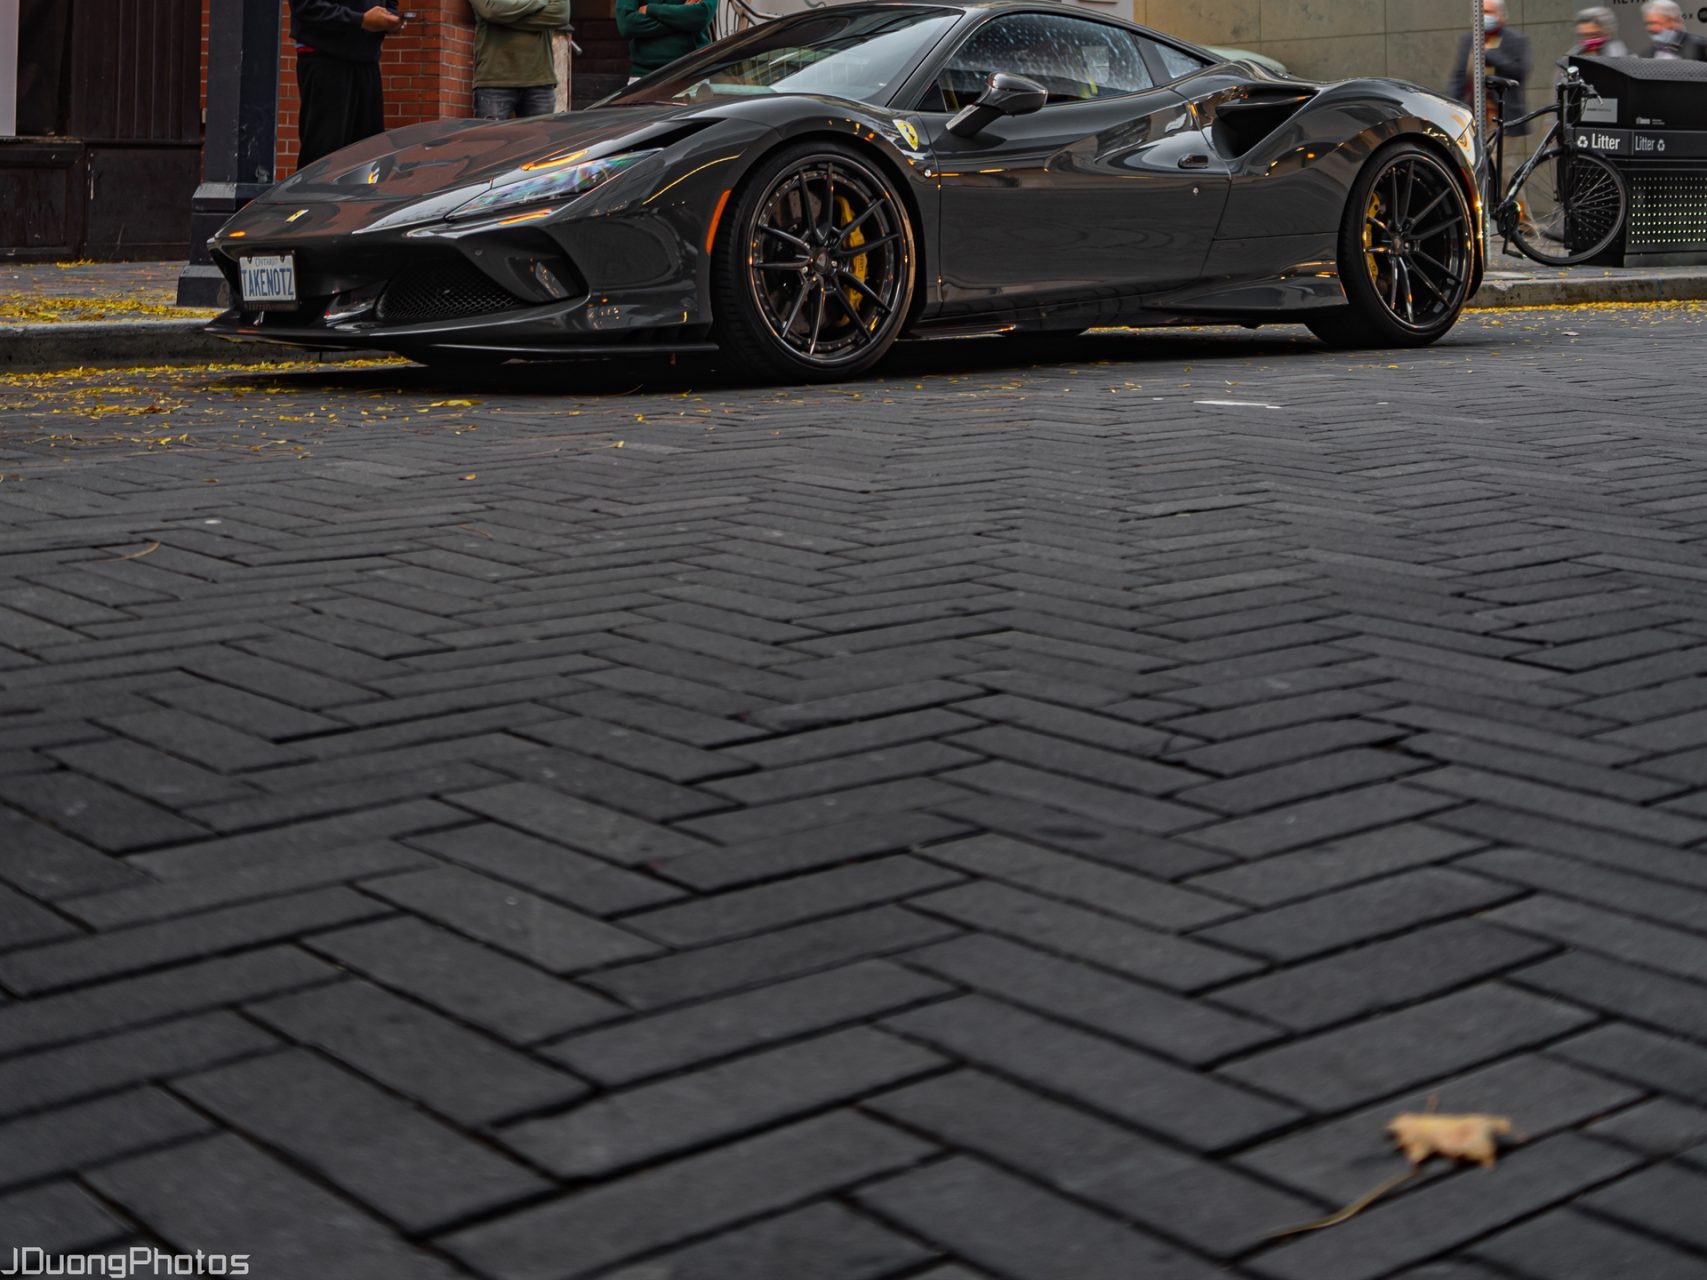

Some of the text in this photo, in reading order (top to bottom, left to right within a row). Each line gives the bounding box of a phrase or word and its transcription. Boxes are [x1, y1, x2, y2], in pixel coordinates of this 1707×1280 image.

[1591, 133, 1620, 150] Litter
[1635, 135, 1655, 151] Litter
[240, 268, 294, 296] TAKENOTZ
